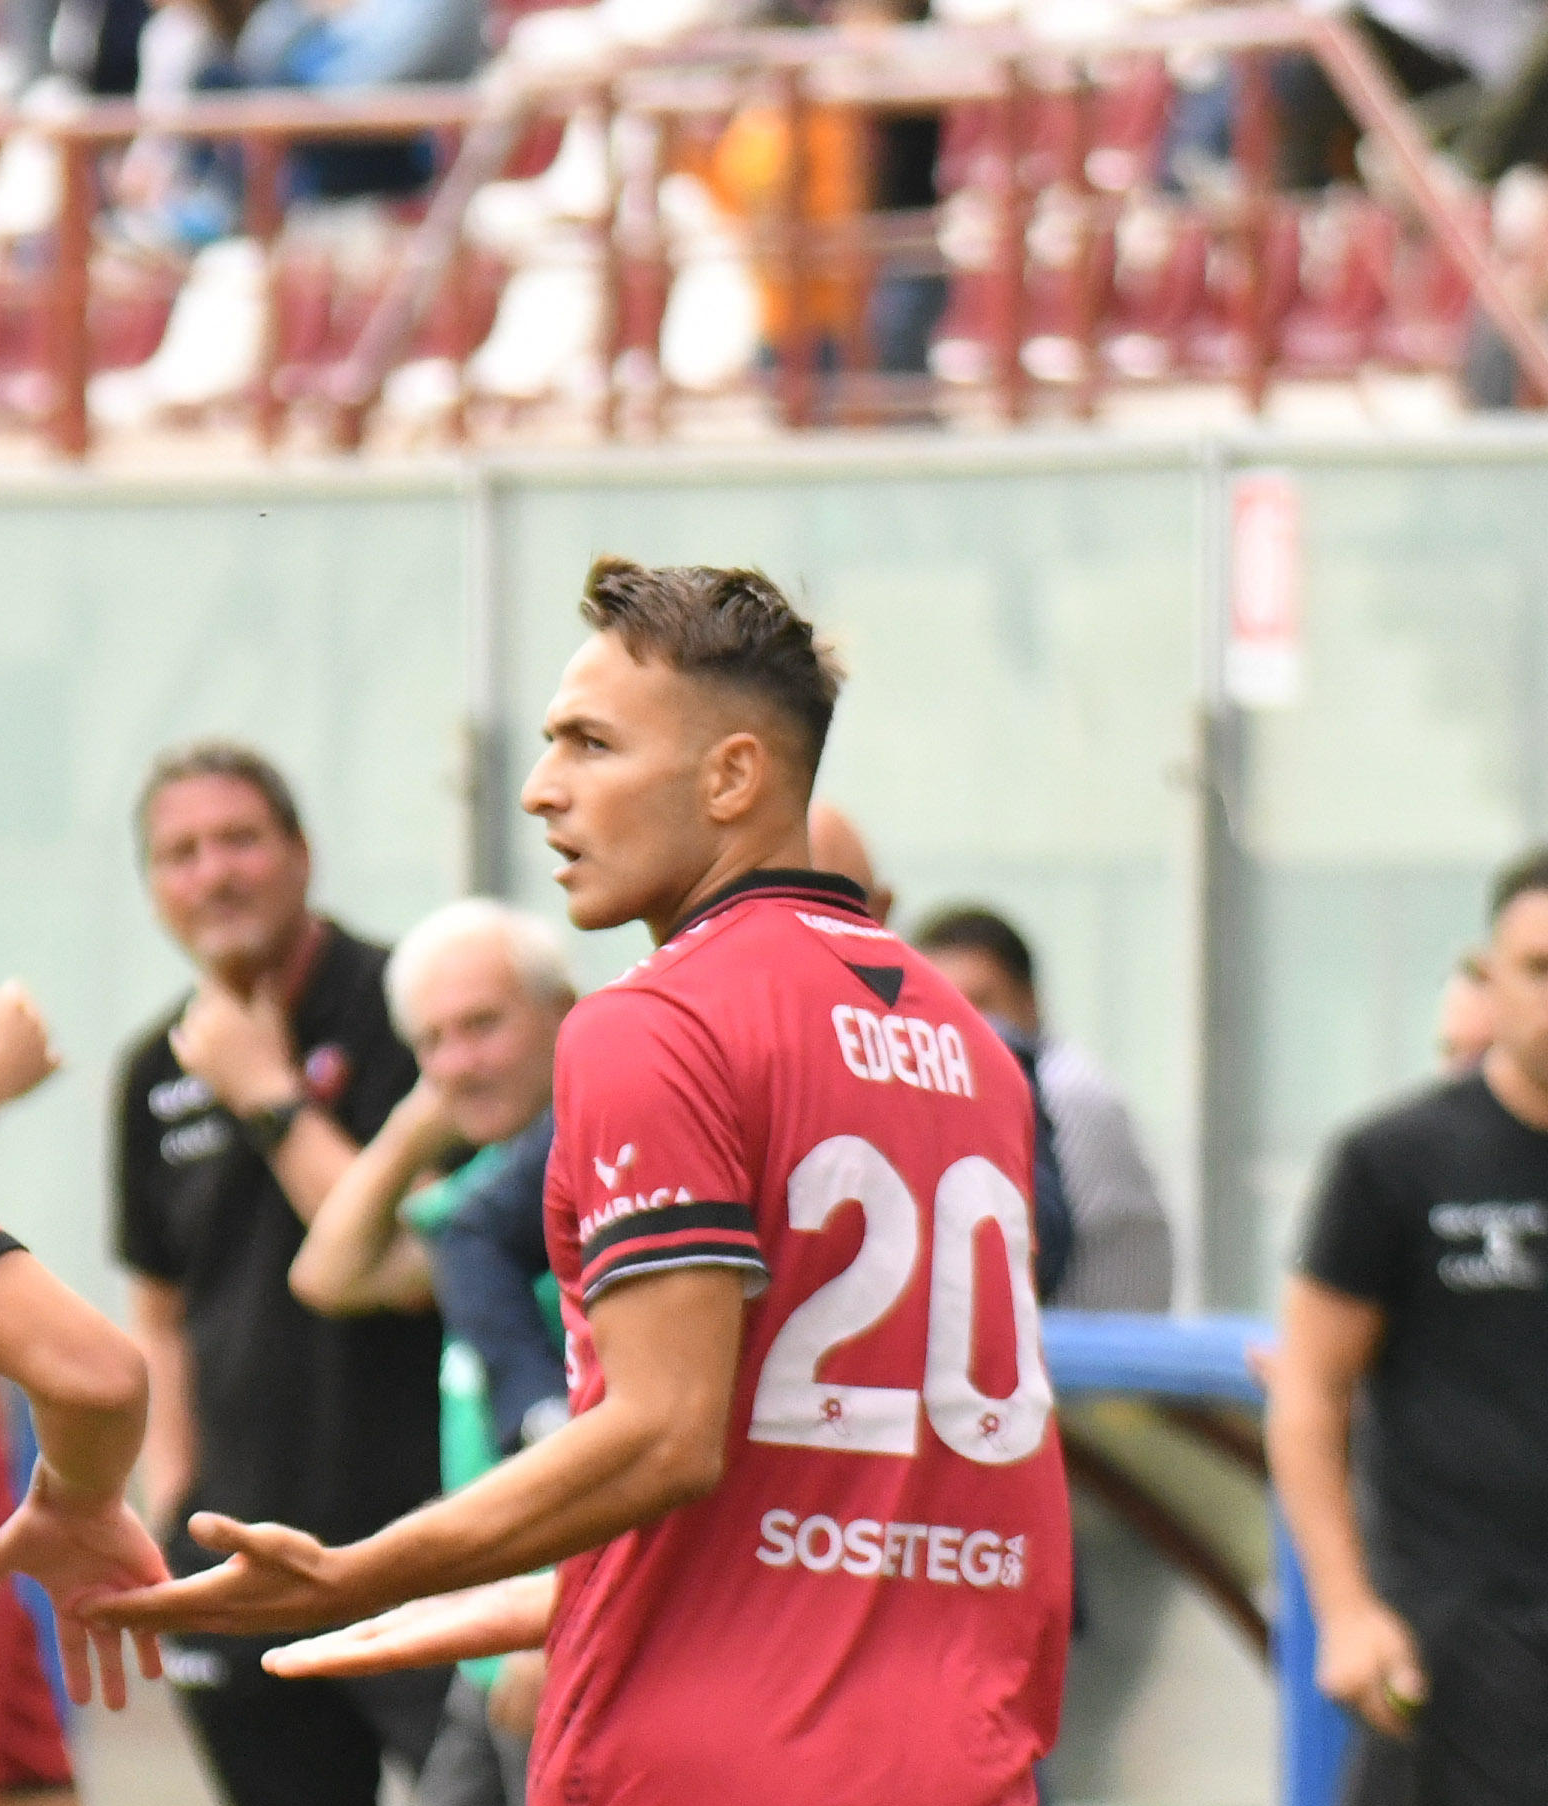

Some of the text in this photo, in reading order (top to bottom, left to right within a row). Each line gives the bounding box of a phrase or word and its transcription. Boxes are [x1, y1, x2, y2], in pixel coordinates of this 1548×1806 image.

[831, 1004, 974, 1099] EDERA
[747, 1134, 1055, 1465] 20
[756, 1508, 1002, 1588] SOSETEG
